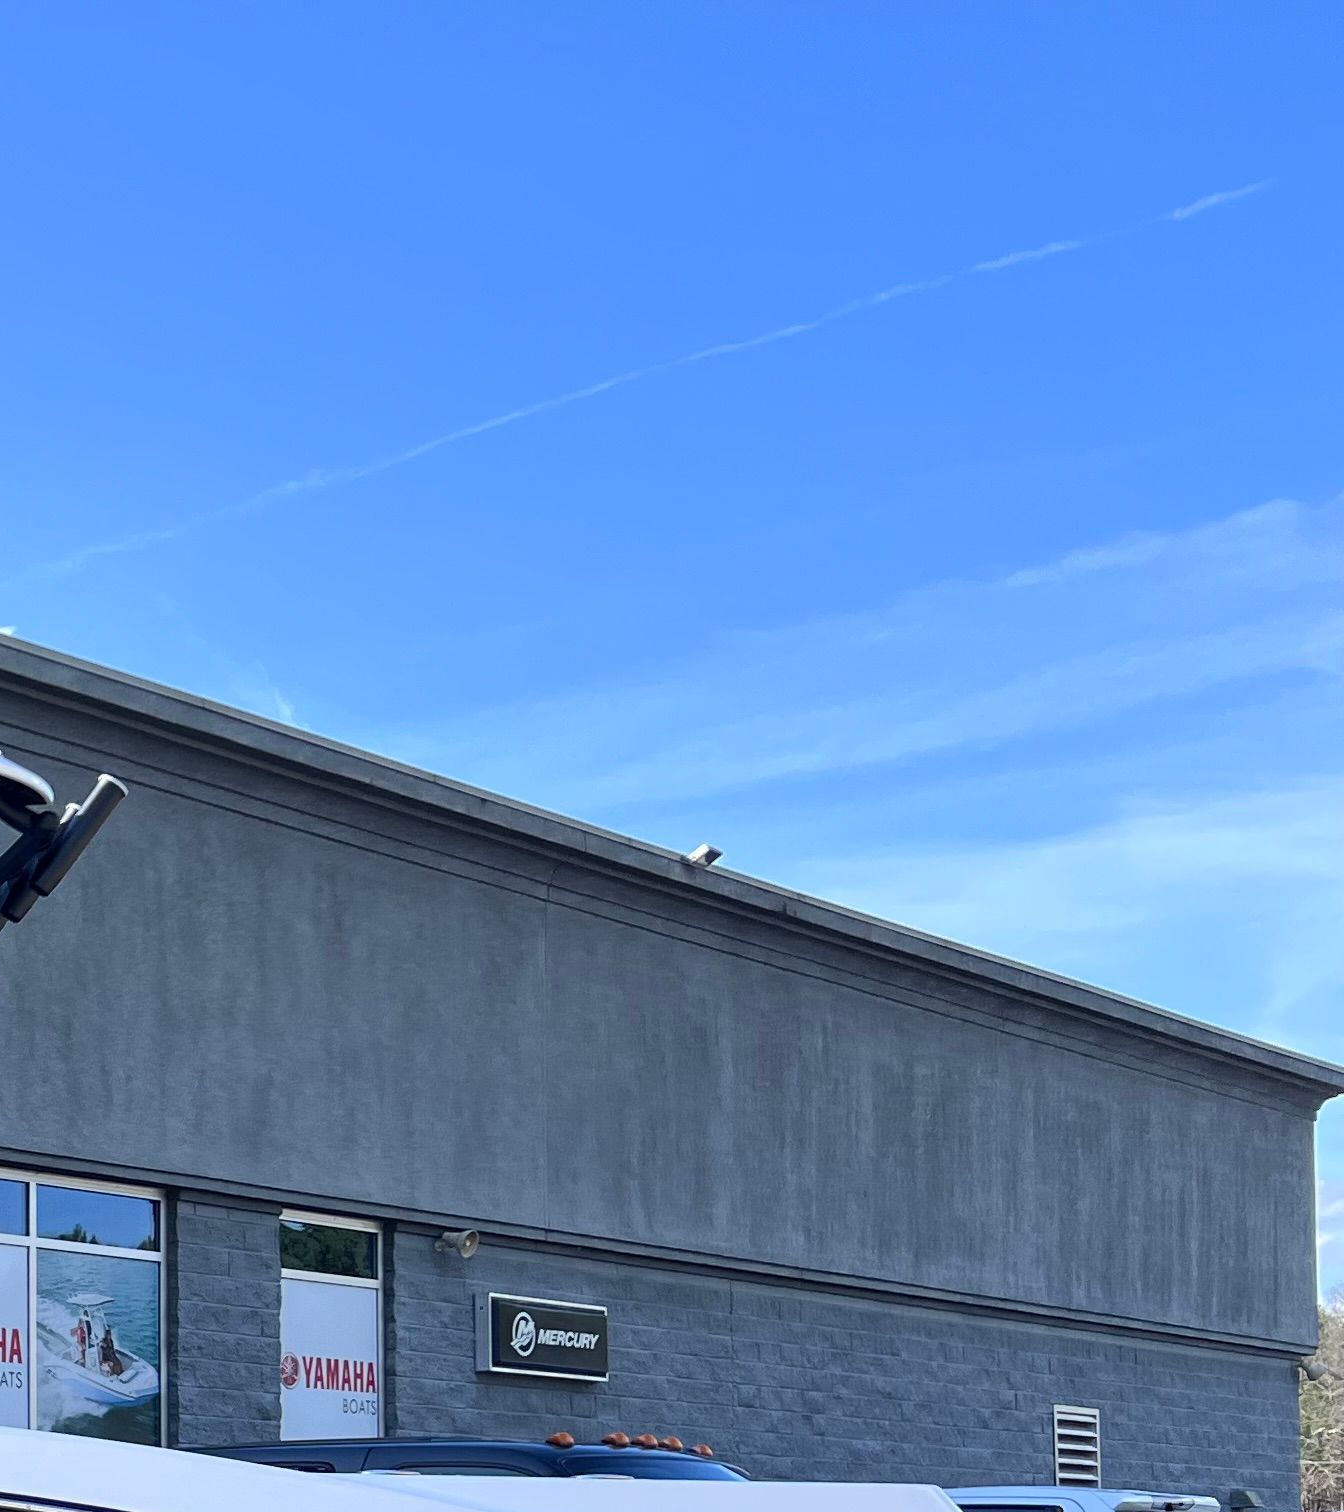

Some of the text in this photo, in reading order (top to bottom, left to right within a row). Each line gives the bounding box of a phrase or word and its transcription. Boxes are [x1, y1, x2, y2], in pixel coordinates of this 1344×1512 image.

[537, 1328, 599, 1350] MERCURY
[302, 1356, 377, 1393] YAMAHA
[343, 1399, 377, 1415] BOATS
